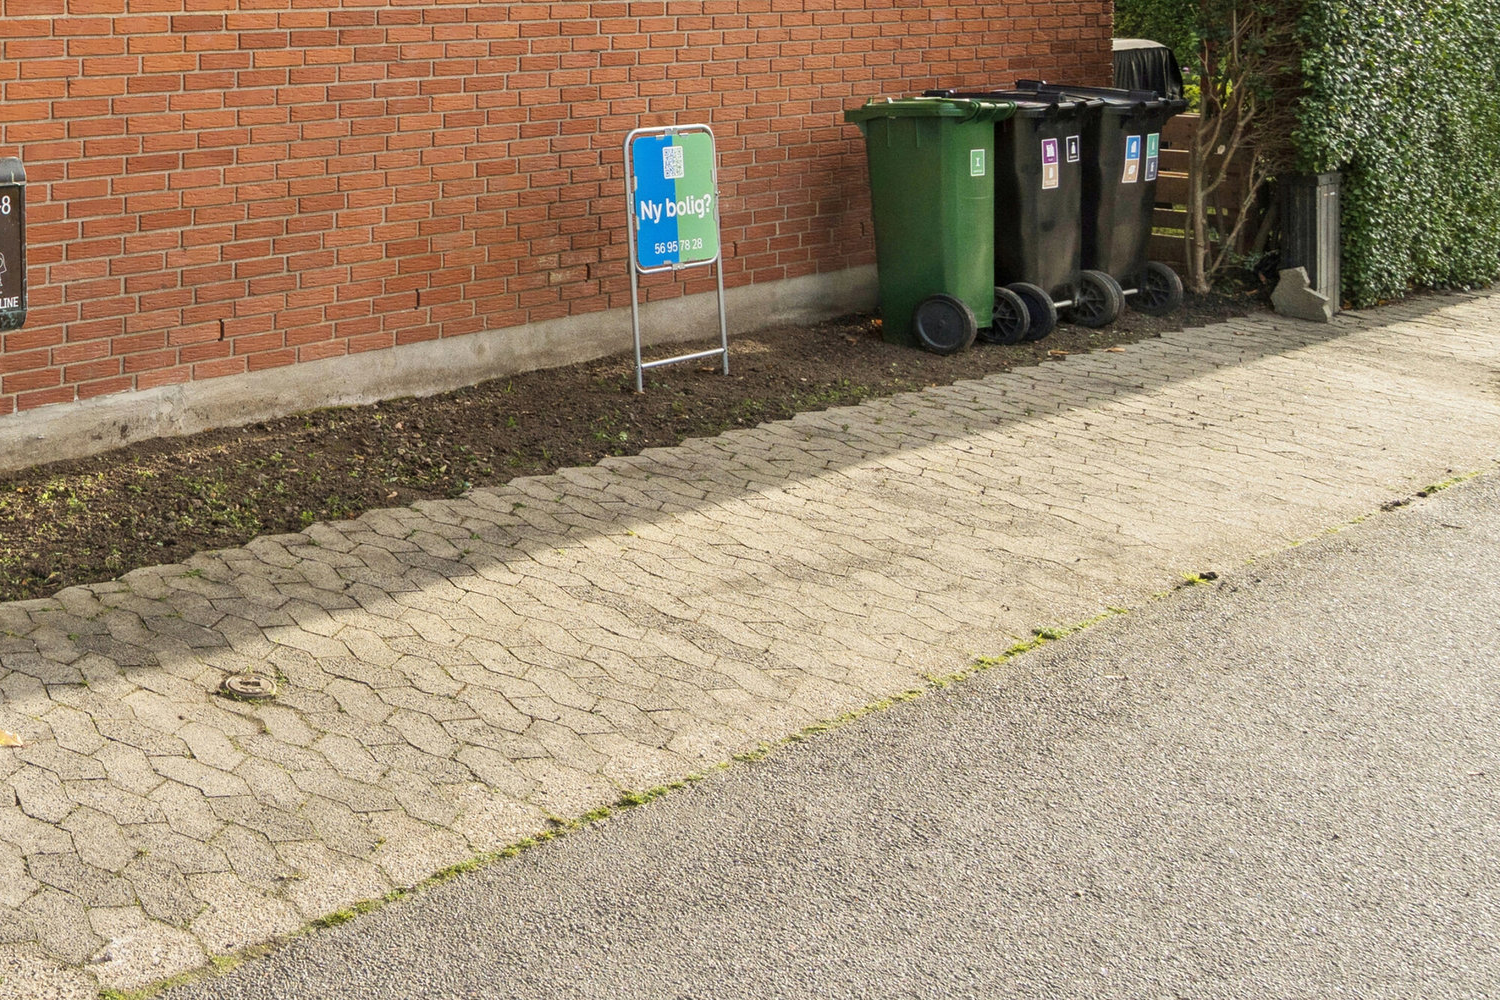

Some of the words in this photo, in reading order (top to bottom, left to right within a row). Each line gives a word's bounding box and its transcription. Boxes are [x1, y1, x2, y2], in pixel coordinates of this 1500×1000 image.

[640, 200, 662, 224] Ny
[665, 193, 711, 219] bolig?
[654, 242, 666, 255] 56
[667, 240, 678, 253] 95
[680, 239, 690, 251] 78
[691, 238, 703, 250] 28
